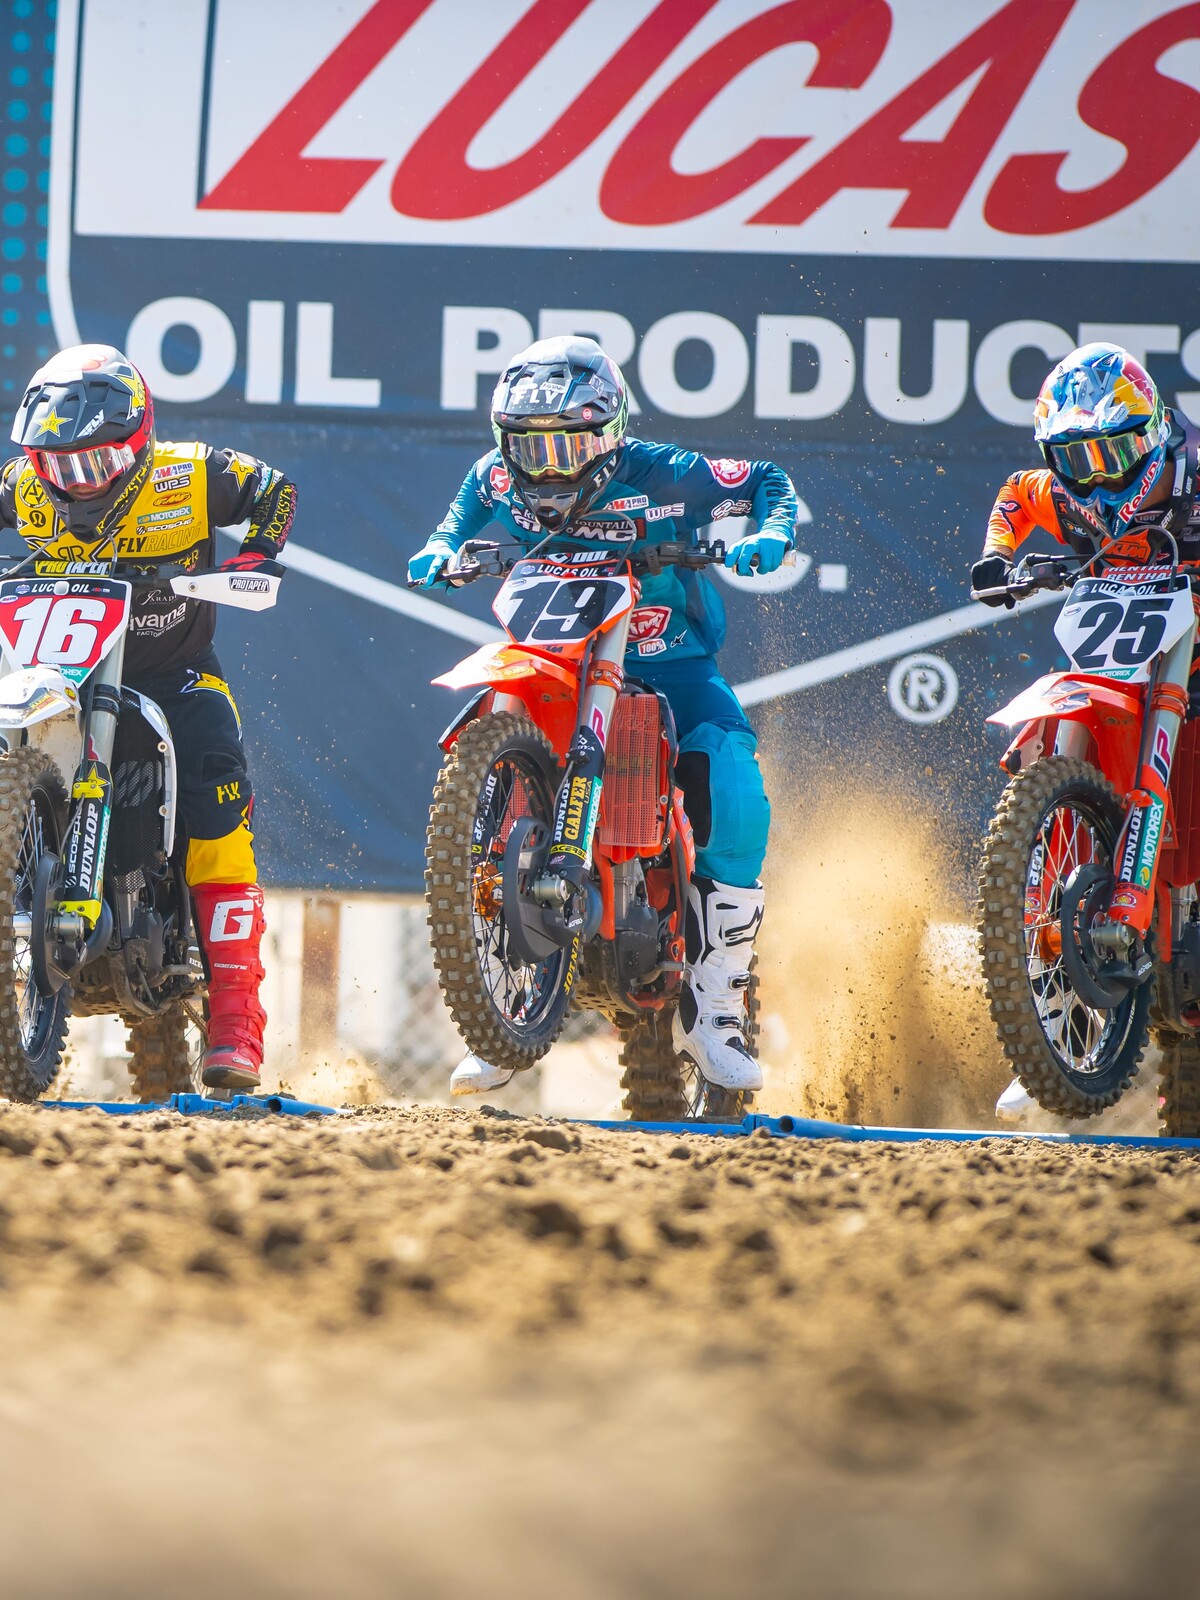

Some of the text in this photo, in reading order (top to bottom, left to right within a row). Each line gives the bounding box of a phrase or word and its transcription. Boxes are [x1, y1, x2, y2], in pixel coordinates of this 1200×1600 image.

[200, 0, 1200, 235] LUCAS
[125, 297, 380, 407] OIL
[511, 389, 557, 405] FLY
[77, 410, 104, 437] FLY
[153, 463, 193, 480] AMA PRO
[155, 477, 190, 493] WPS
[150, 507, 190, 521] MOTOREX
[603, 496, 647, 511] AMA PRO
[646, 503, 685, 521] WPS
[1106, 540, 1149, 563] KTM
[537, 564, 600, 577] LUCAS OIL
[31, 583, 90, 593] LUC OIL
[231, 578, 268, 591] PROTAPER
[1136, 584, 1156, 595] OIL
[507, 579, 626, 643] 19
[13, 597, 106, 666] 16
[1072, 599, 1173, 669] 25
[641, 640, 664, 653] 100%
[584, 779, 592, 805] USA
[554, 780, 570, 843] DUNLOP
[565, 776, 588, 841] GALFER
[587, 783, 603, 838] MOTOREX
[1121, 806, 1143, 881] DUNLOP
[1141, 801, 1164, 866] MOTOREX
[80, 803, 99, 892] DUNLOP
